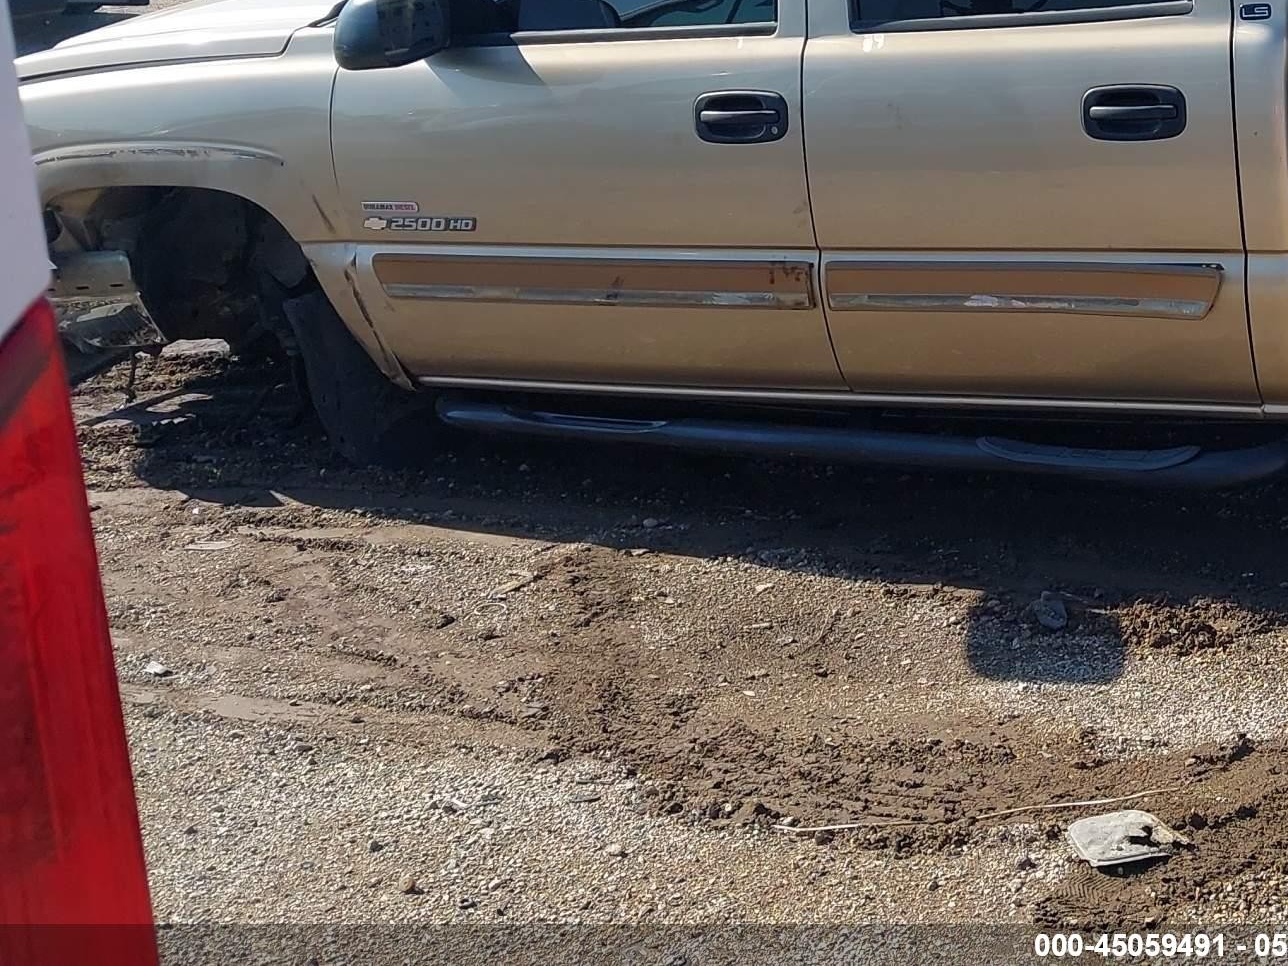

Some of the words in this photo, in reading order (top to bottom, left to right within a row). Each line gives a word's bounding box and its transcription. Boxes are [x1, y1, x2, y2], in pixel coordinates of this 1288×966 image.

[1242, 6, 1270, 18] LS
[391, 217, 445, 231] 2500
[449, 218, 474, 231] HD
